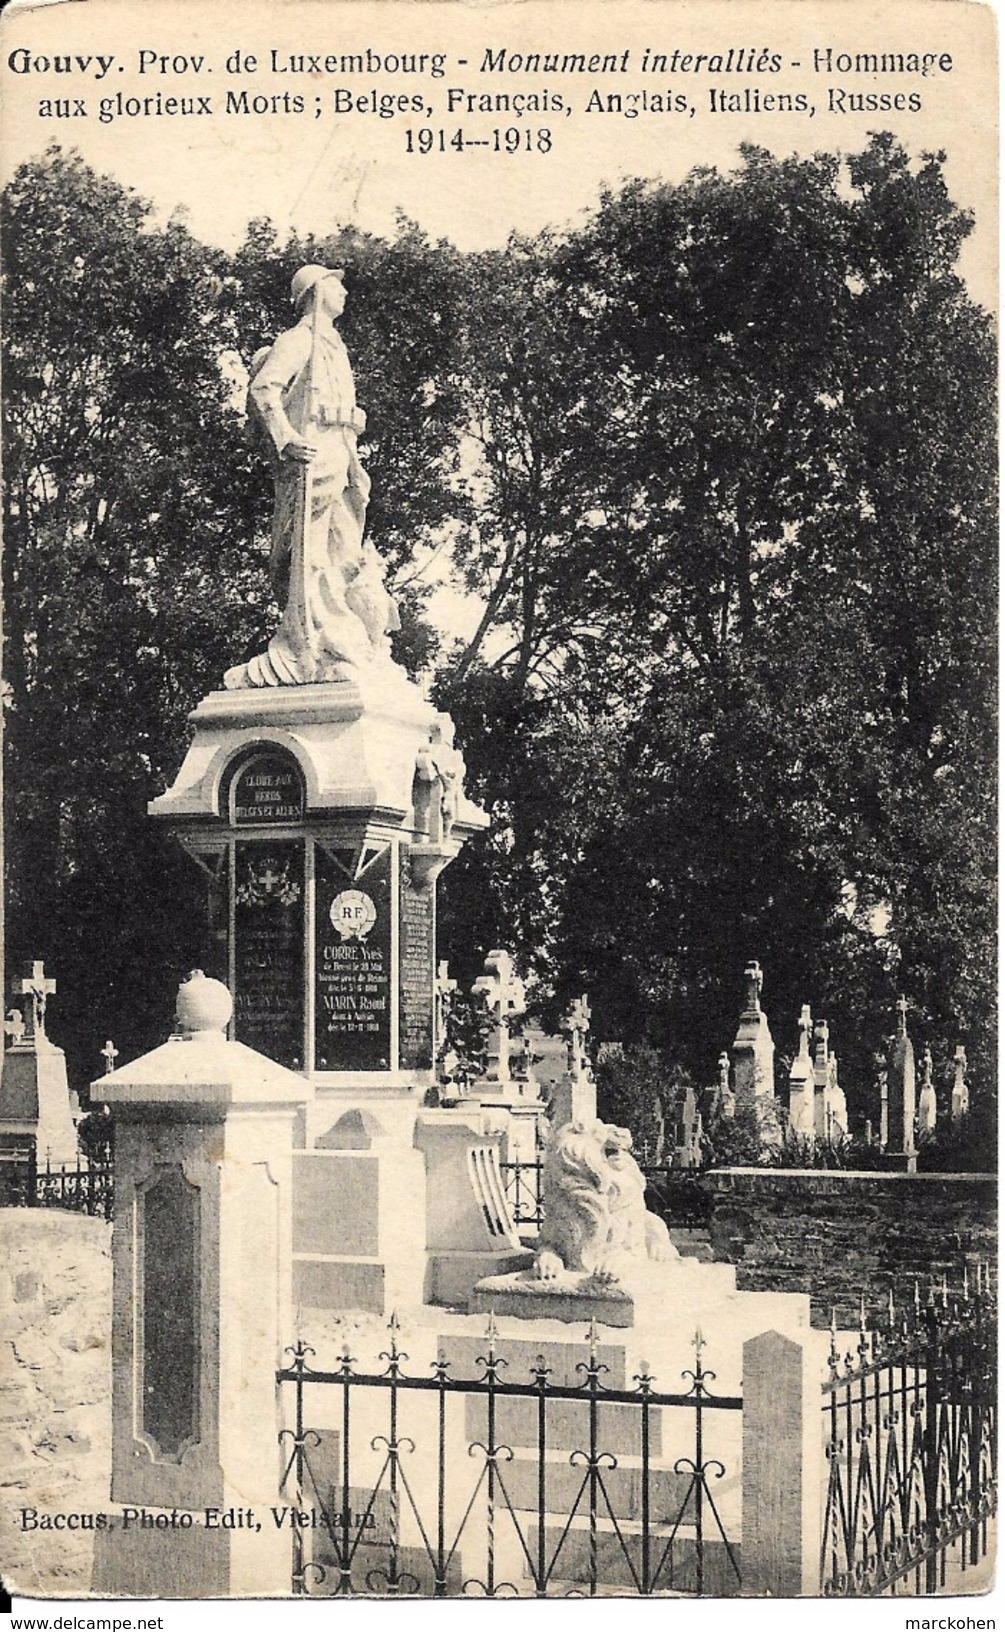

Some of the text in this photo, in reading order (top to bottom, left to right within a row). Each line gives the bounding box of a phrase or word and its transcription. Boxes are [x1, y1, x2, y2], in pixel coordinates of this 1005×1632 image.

[324, 945, 384, 960] CORRE Yves
[323, 996, 356, 1010] MARIN
